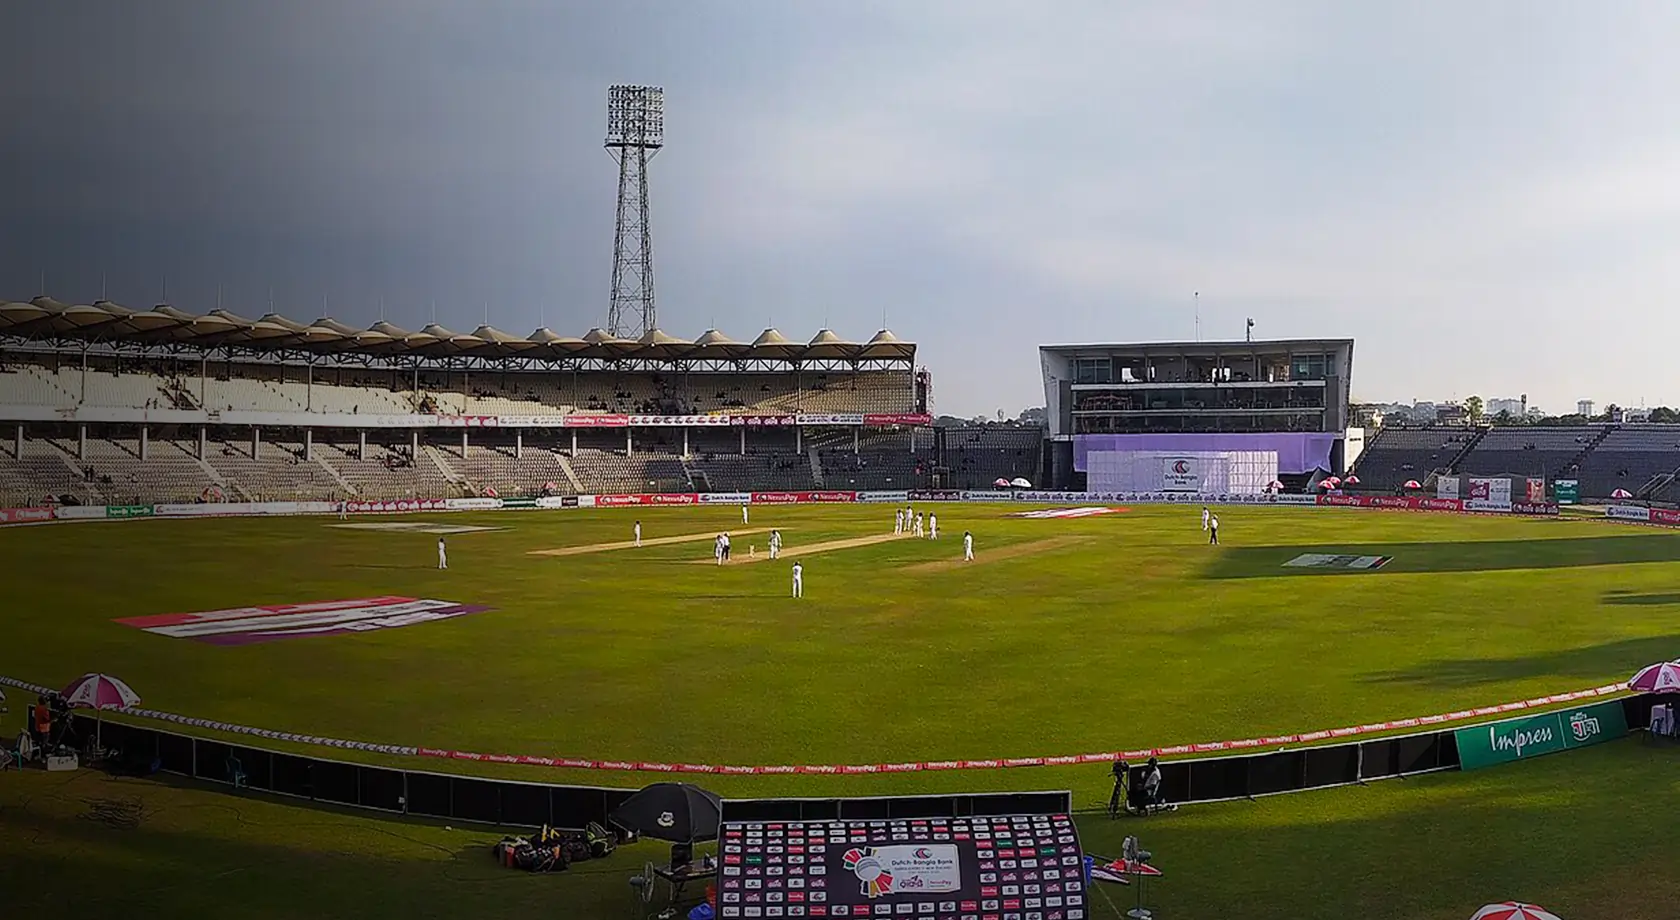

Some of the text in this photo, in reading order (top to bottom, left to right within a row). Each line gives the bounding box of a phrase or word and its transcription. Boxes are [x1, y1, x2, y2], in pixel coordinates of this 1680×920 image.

[611, 496, 642, 504] NexusPay
[663, 496, 693, 504] NexusPay
[767, 494, 798, 503] NexusPay
[1332, 496, 1362, 506] NexusPay
[1381, 498, 1410, 508] NexusPay
[1429, 500, 1459, 510] NexusPay
[1489, 726, 1553, 757] Impress
